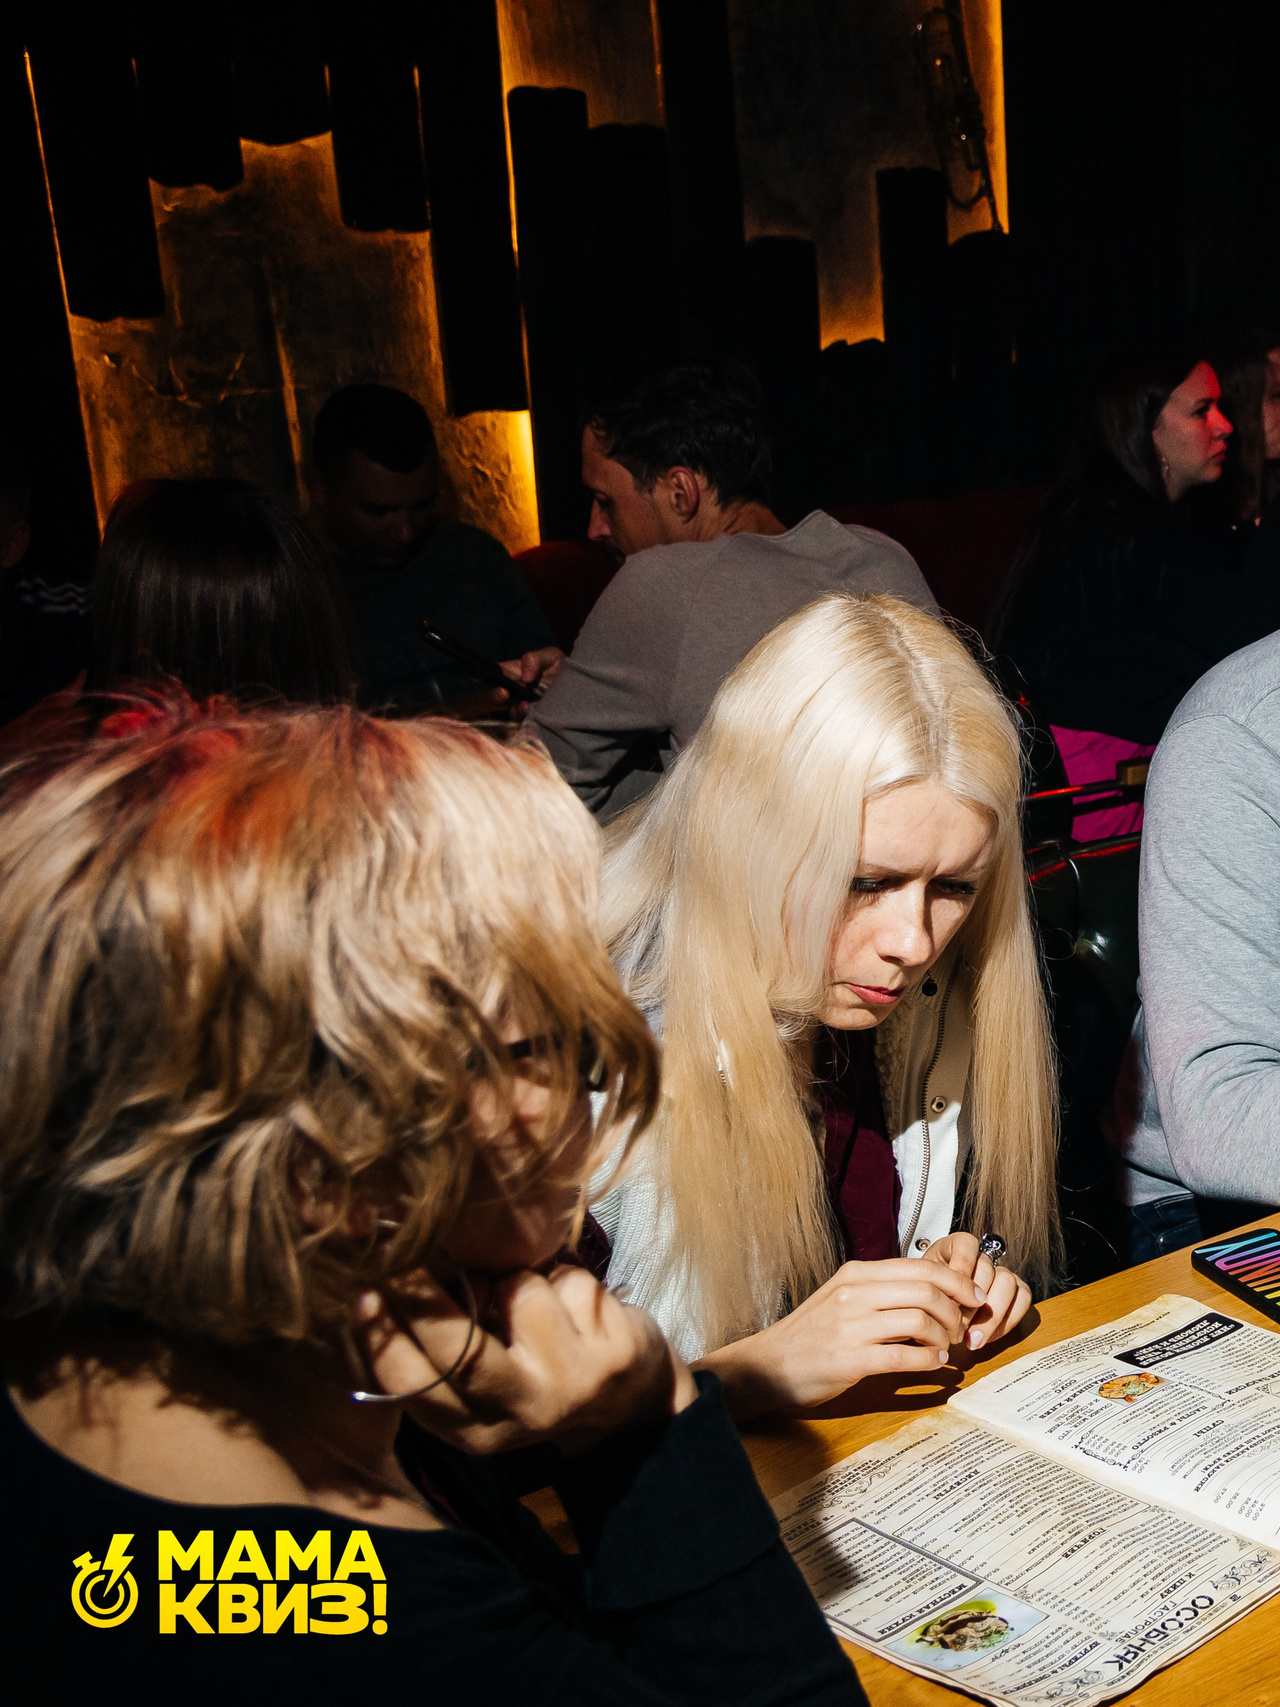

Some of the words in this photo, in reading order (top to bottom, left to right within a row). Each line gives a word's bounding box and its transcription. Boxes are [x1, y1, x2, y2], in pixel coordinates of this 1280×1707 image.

[1052, 1379, 1078, 1393] СОУС
[1191, 1418, 1225, 1437] СУПЫ
[930, 1469, 982, 1500] ДЕСЕРТЫ
[1060, 1527, 1107, 1558] ГОРЯЧЕЕ
[914, 1583, 967, 1614] МЕСТНАЯ
[877, 1612, 916, 1635] КУХНЯ
[1100, 1593, 1219, 1672] ОСОБНЯК
[1113, 1600, 1178, 1644] ГАСТРОПАБ
